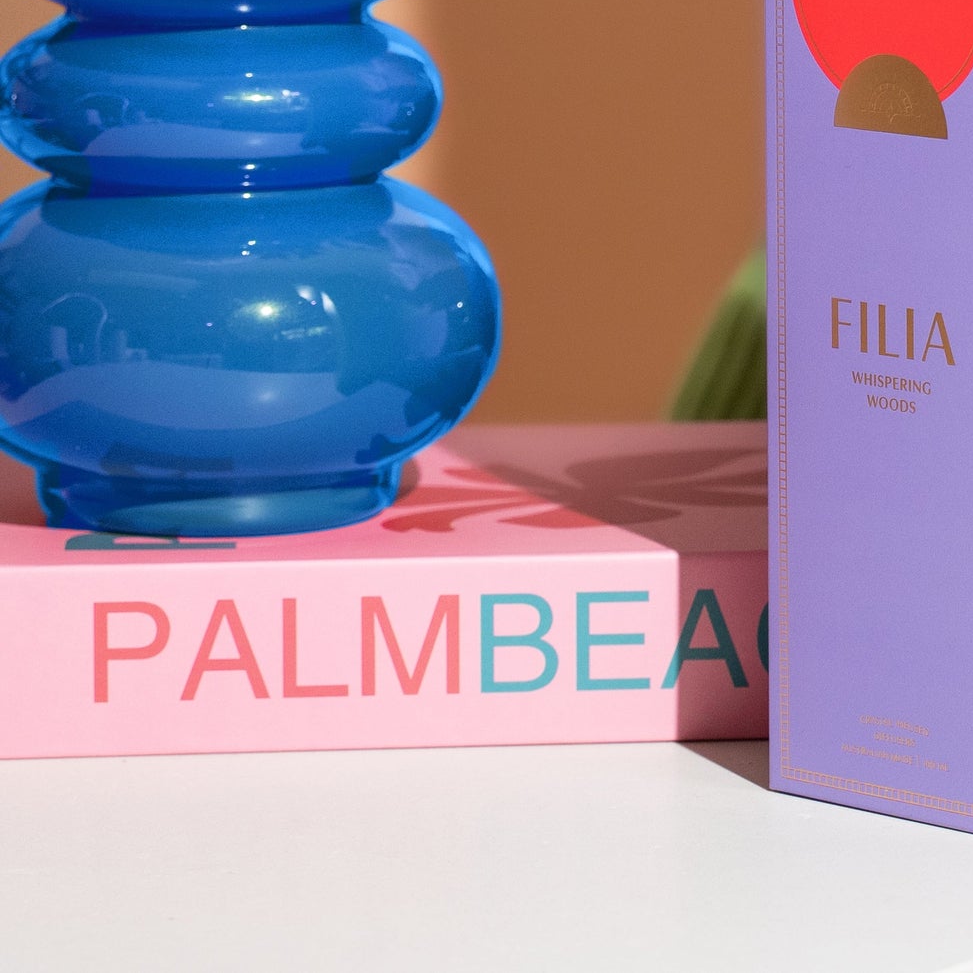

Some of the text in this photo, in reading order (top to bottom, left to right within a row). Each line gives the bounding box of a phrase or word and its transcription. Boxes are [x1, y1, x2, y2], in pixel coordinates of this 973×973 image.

[831, 297, 956, 366] FILIA
[852, 371, 932, 395] WHISPERING
[867, 395, 917, 414] WOODS
[92, 588, 770, 703] PALMBEA
